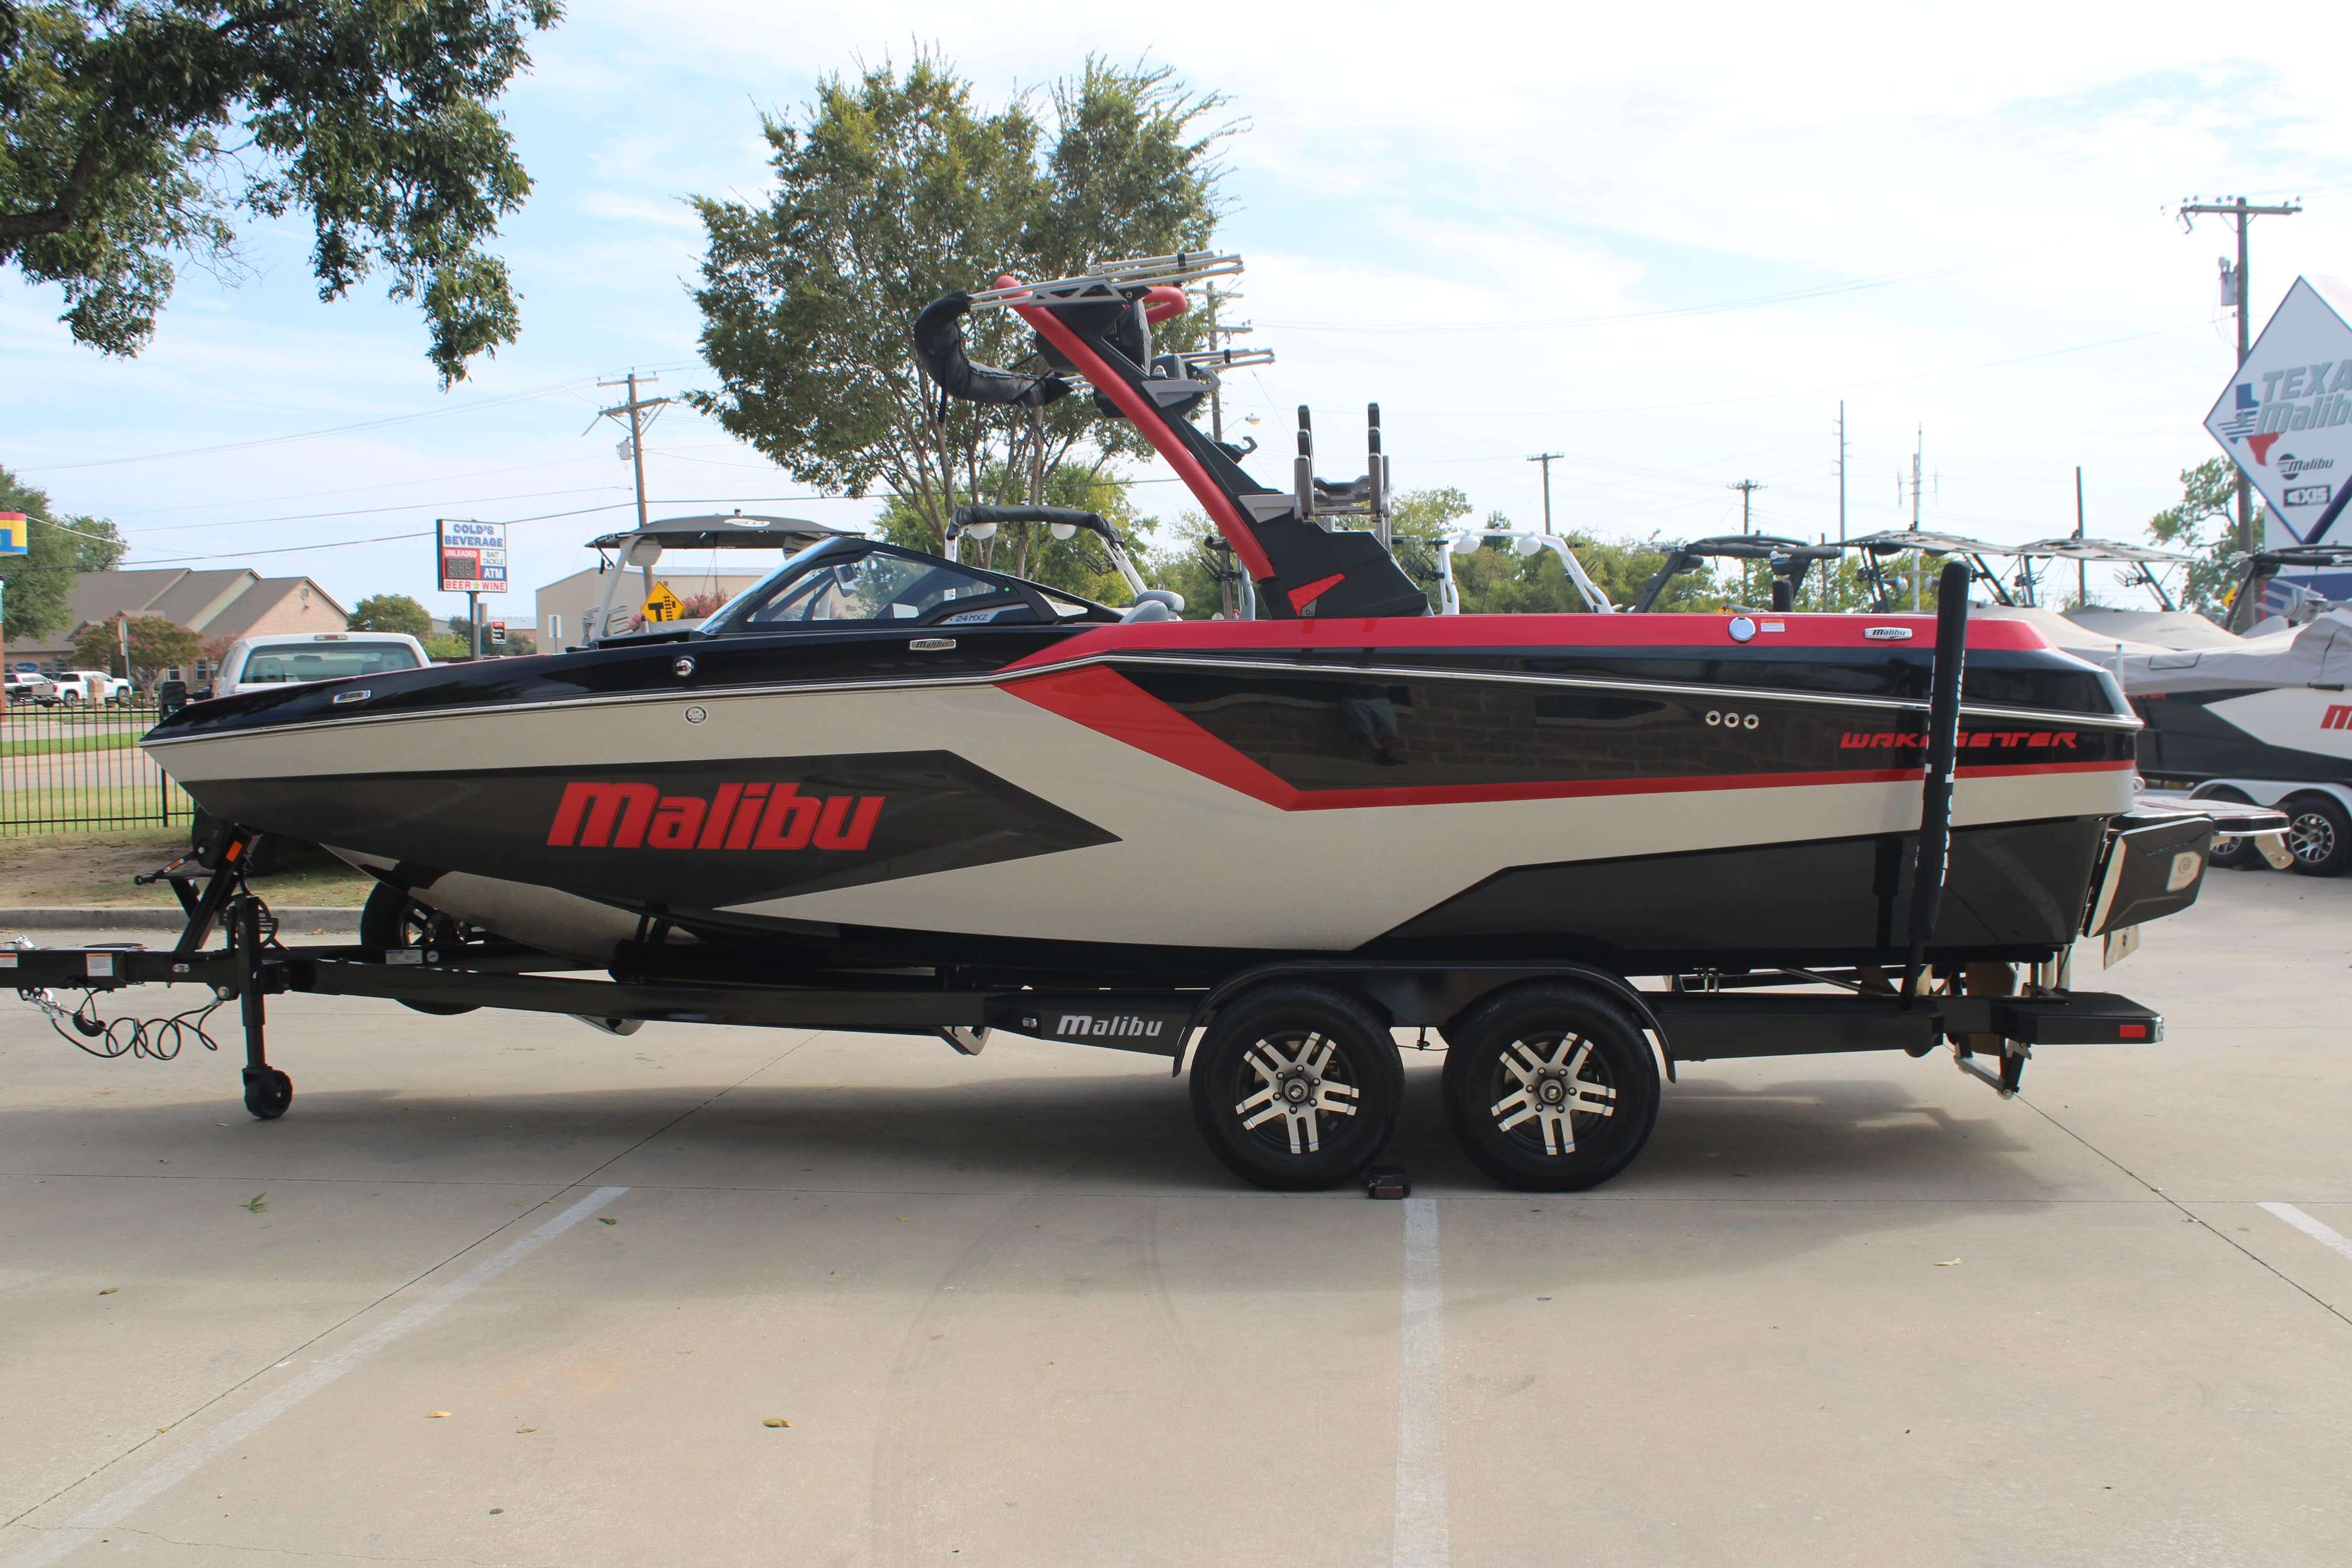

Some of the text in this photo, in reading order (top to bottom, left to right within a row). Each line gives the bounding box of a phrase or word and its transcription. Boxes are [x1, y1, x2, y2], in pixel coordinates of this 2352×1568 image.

[2254, 393, 2352, 436] Malib
[2288, 458, 2334, 472] Malibu
[453, 524, 494, 535] COLD'S
[444, 535, 503, 547] BEVERAGE
[445, 549, 477, 557] UNLEADED
[484, 567, 503, 579] ATM
[445, 580, 506, 590] BEER WINE
[546, 782, 886, 850] Malibu
[1056, 1015, 1163, 1037] Malibu
